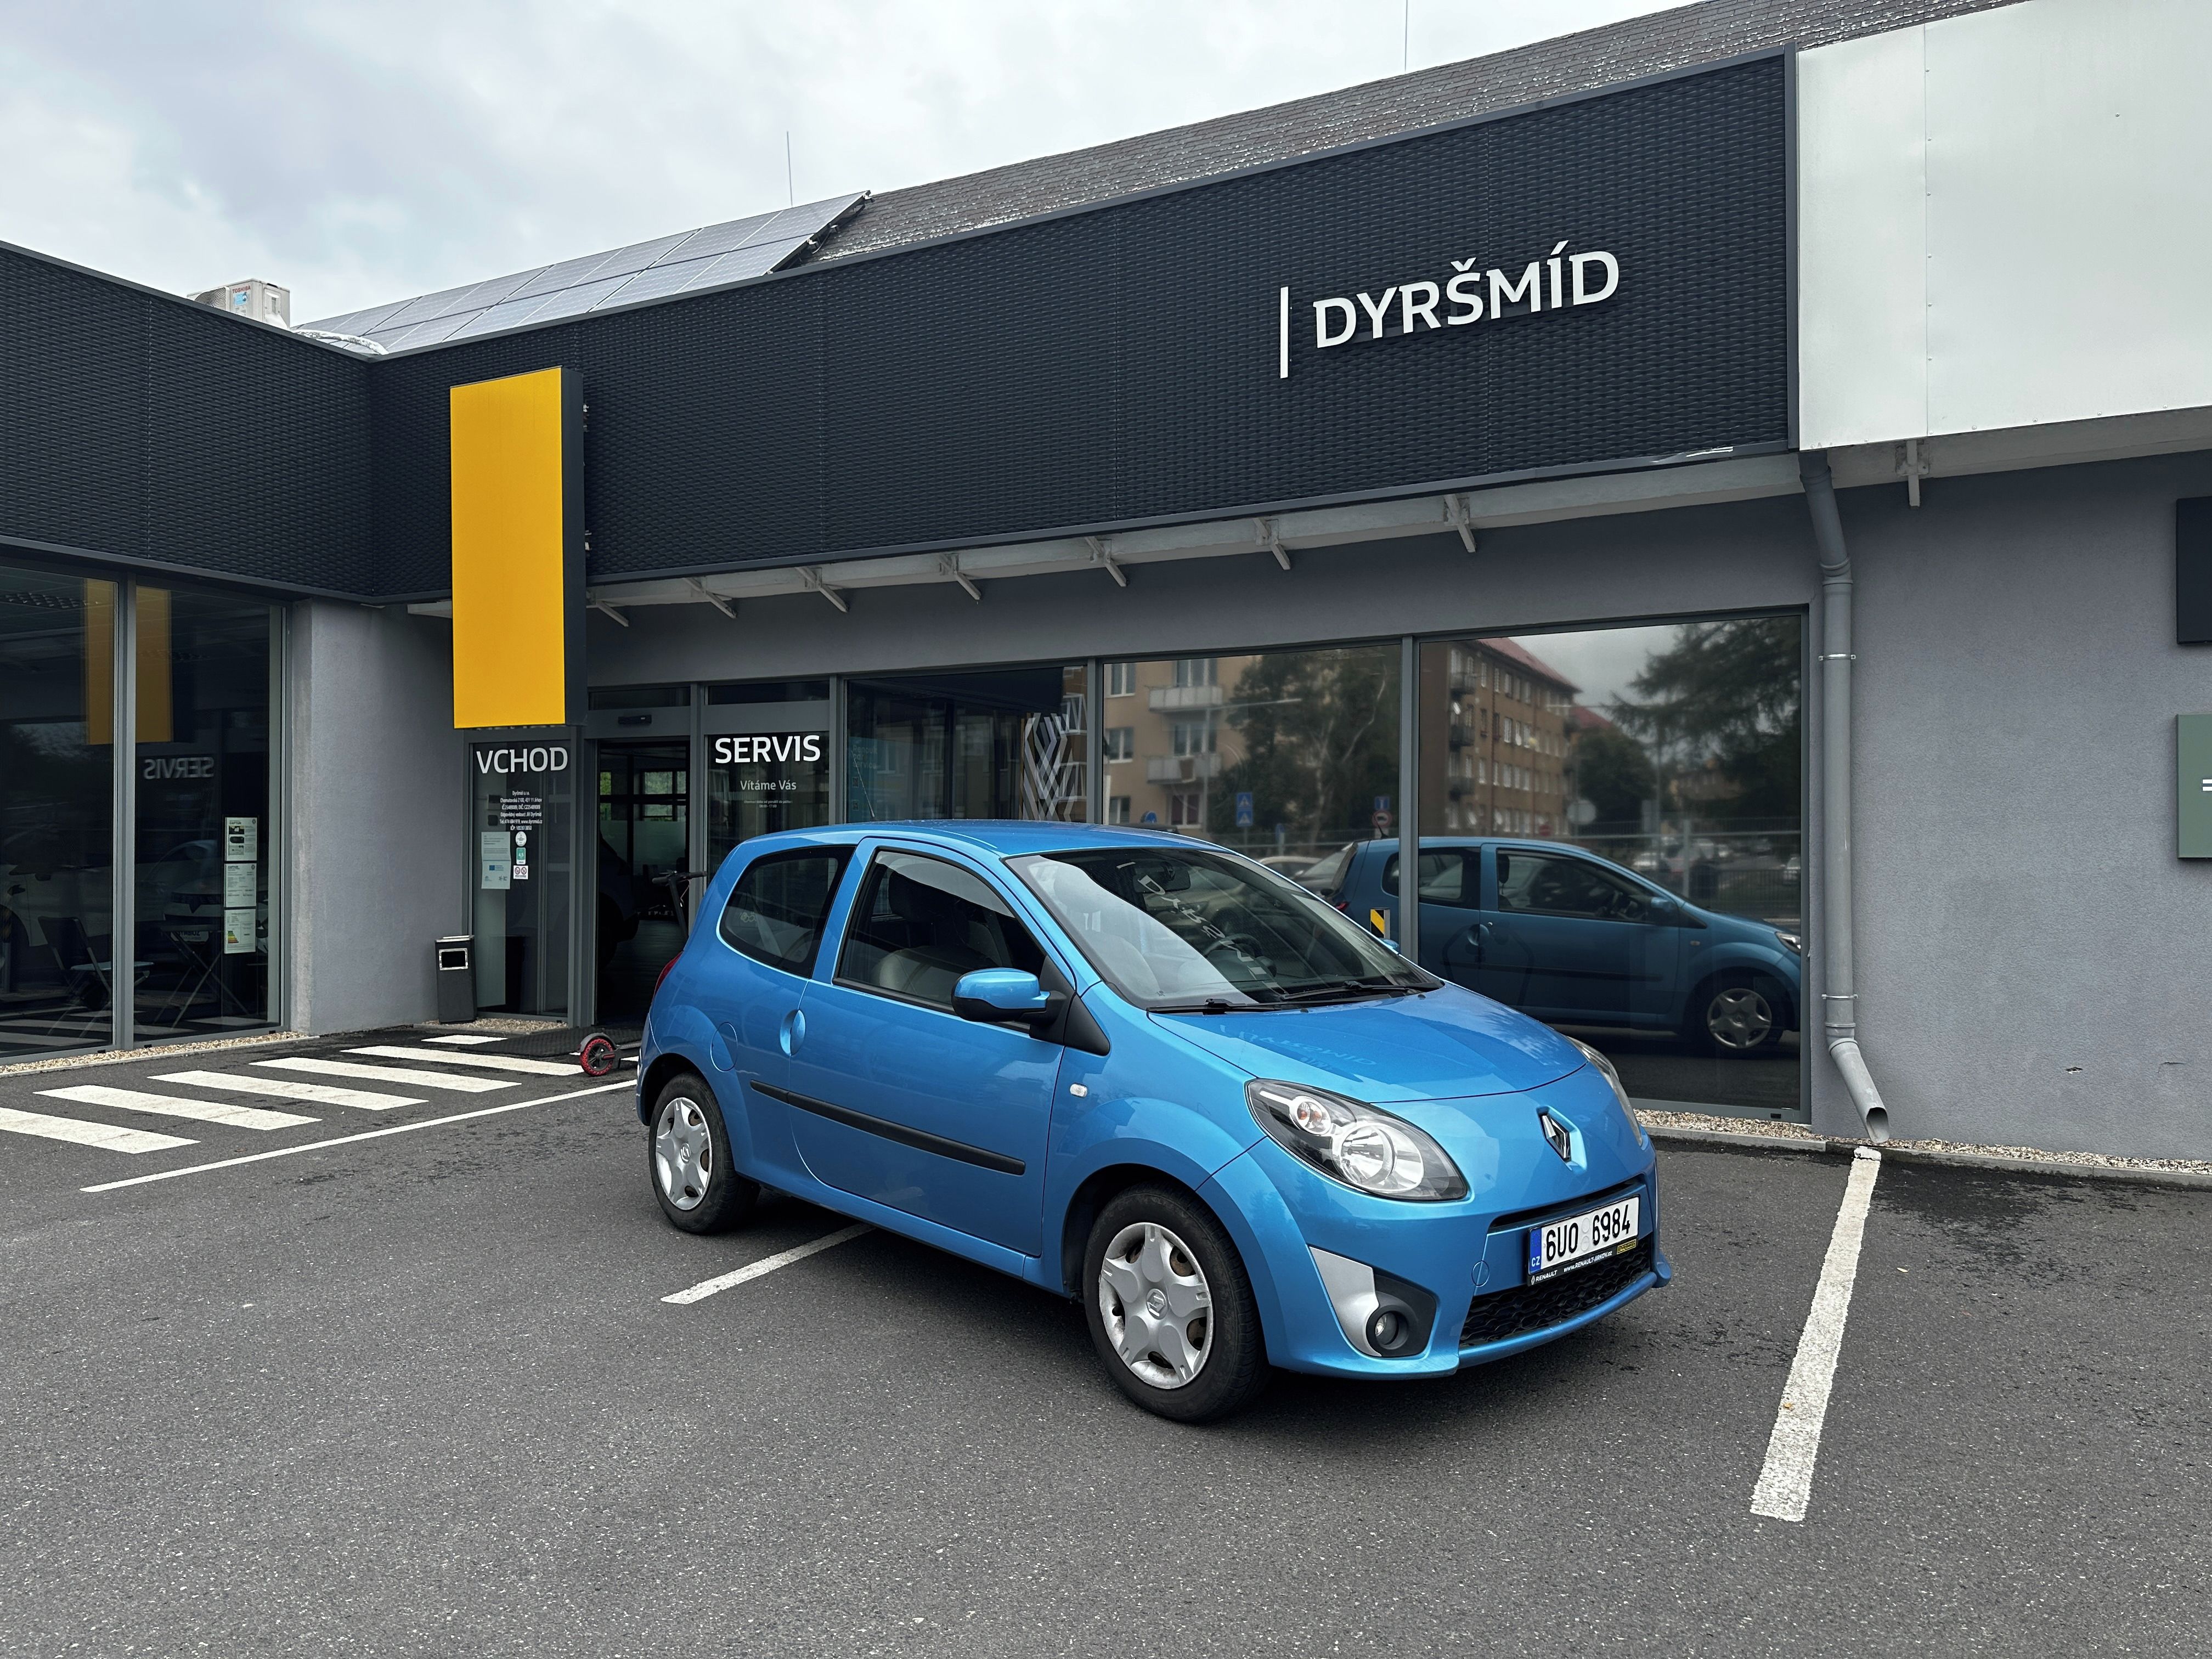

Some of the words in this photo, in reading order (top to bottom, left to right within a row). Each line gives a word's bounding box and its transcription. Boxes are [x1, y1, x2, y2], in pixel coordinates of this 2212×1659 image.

[232, 285, 251, 294] TOSHIBA
[1313, 240, 1619, 348] DYRŠMÍD
[715, 735, 821, 764] SERVIS
[476, 747, 568, 774] VCHOD
[740, 780, 776, 791] Vítáme
[778, 780, 797, 791] Vás
[1592, 1204, 1630, 1246] 6984
[1531, 1255, 1541, 1267] CZ
[1536, 1269, 1558, 1282] RENAULT
